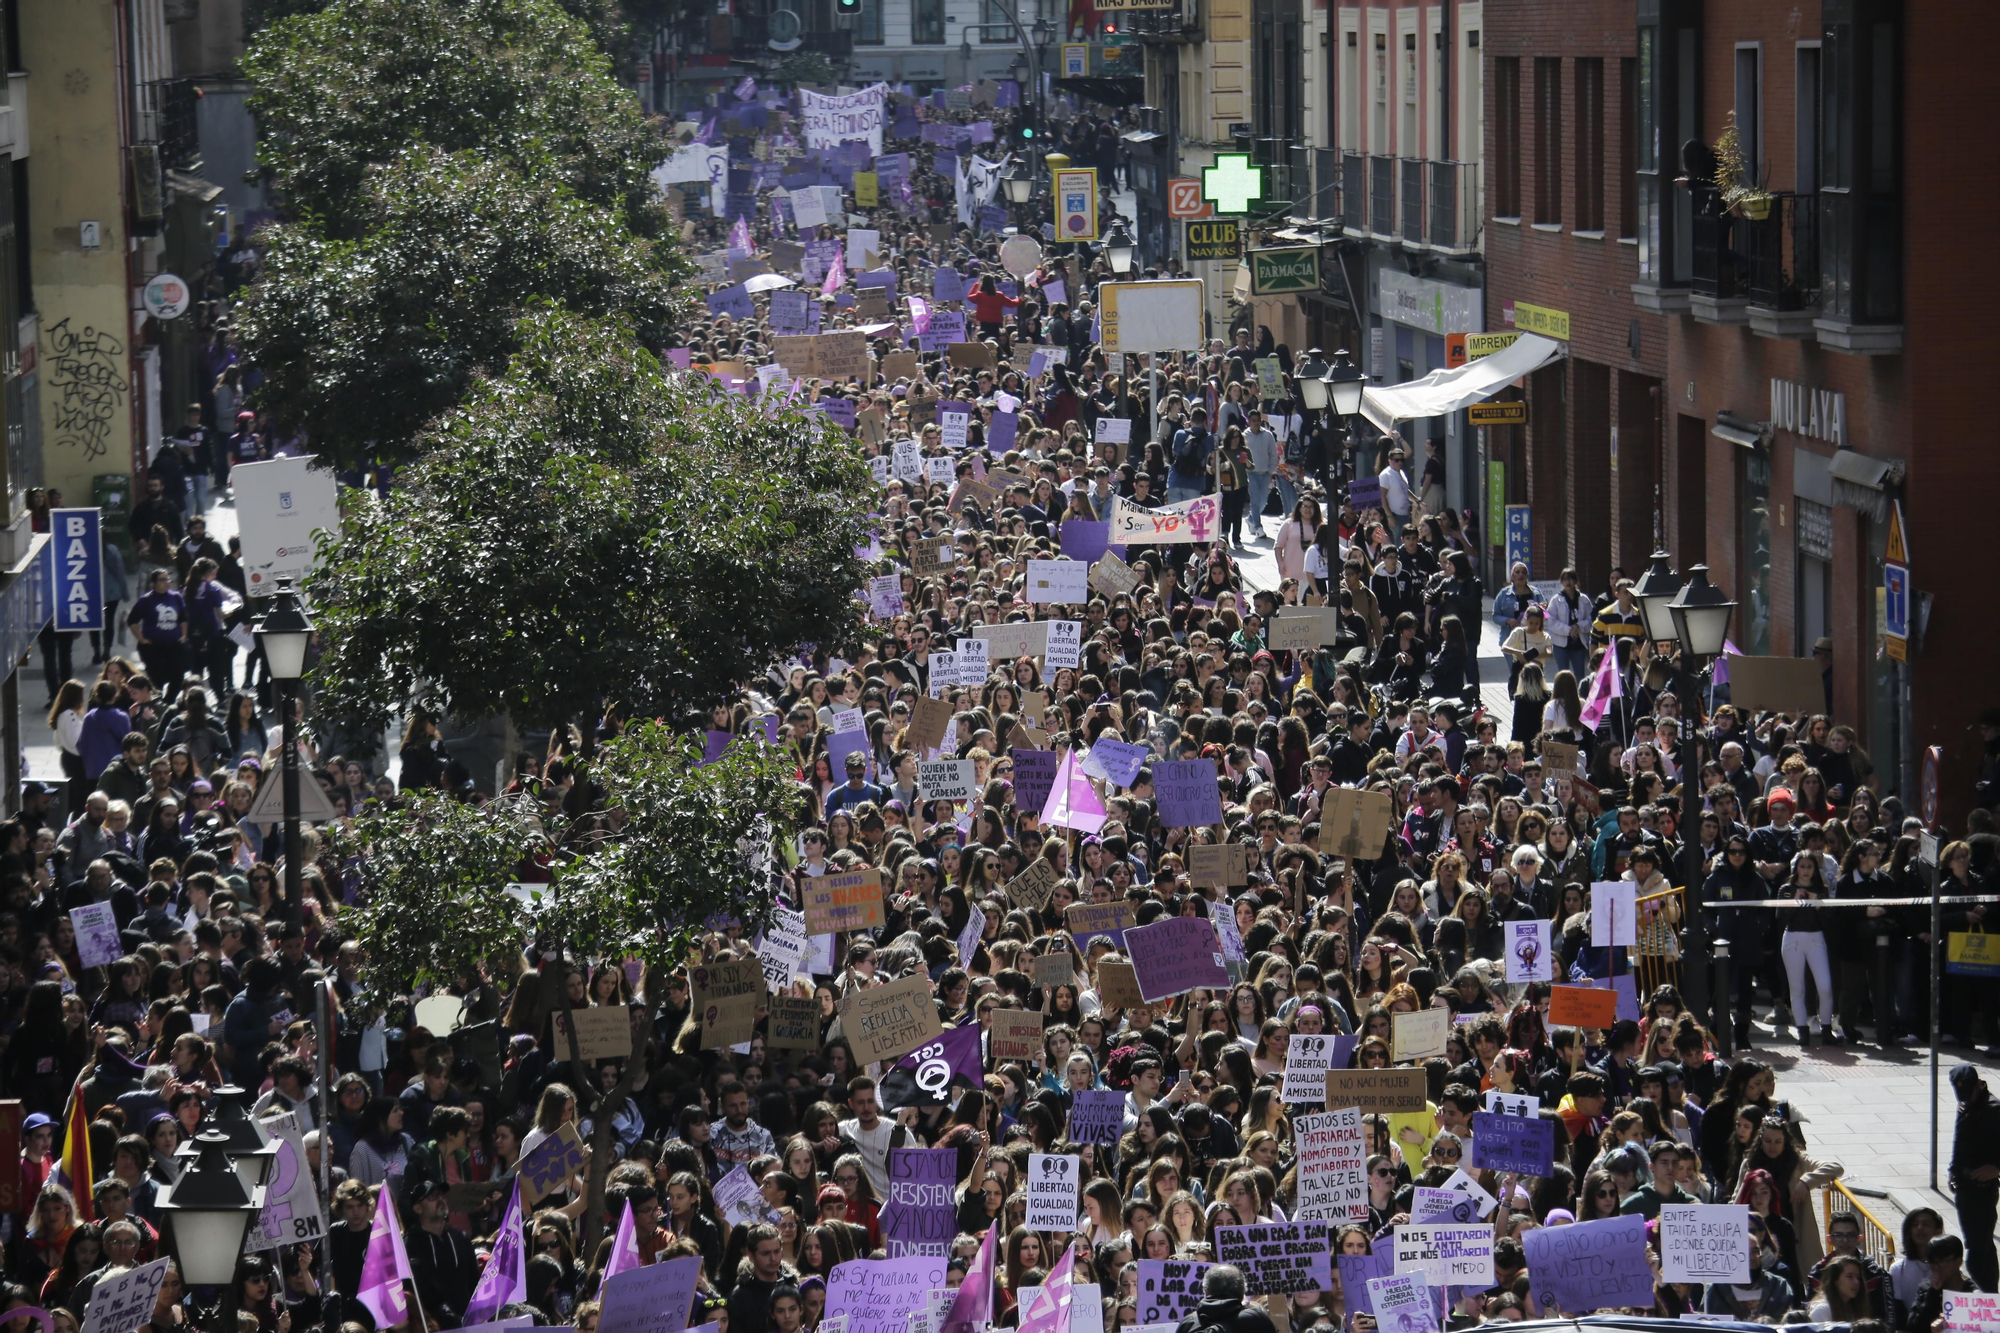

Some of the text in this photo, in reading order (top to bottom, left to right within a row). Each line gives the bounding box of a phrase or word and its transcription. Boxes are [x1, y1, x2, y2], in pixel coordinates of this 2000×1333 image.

[1189, 223, 1237, 244] CLUB
[1190, 247, 1236, 257] NAYKAS
[1259, 263, 1314, 279] FARMACIA
[1771, 378, 1844, 446] MULAYA
[898, 444, 915, 454] JUS-
[1492, 463, 1500, 544] INTERNET
[1125, 516, 1179, 533] Ser YO
[915, 555, 939, 566] ABAJO
[66, 516, 90, 624] BAZAR
[1048, 637, 1078, 645] LIBERTAD,
[1048, 647, 1078, 656] IGUALDAD,
[1047, 656, 1077, 665] AMISTAD.
[921, 763, 957, 774] QUIEN NO
[1039, 757, 1047, 766] EL
[921, 772, 959, 782] MUEVE NO
[930, 786, 968, 798] CADENAS
[804, 874, 864, 892] SE DEBEMOS
[1010, 860, 1050, 897] QUE LAS
[815, 884, 882, 906] LAS MUJERES
[809, 905, 858, 919] QUE NUNCA
[1069, 911, 1078, 924] EL
[813, 916, 864, 931] VOLVIERON
[1960, 951, 1991, 962] MARINA
[709, 966, 741, 985] NO SOY
[709, 981, 756, 997] TUYA NI DE
[772, 997, 819, 1009] LO CONTRARIO
[859, 989, 915, 1015] Sembraremos
[770, 1009, 780, 1019] AL
[773, 1026, 814, 1040] IGNORANCIA
[871, 1021, 928, 1054] LIBERTAD
[1340, 1074, 1409, 1090] NO NACÍ MUJER
[1094, 1091, 1107, 1102] NOS
[1286, 1087, 1325, 1098] AMISTAD.
[1330, 1095, 1422, 1108] PARA MORIR POR SERLO
[1310, 1112, 1356, 1131] DIOS ES
[1494, 1119, 1525, 1133] ELIJO
[1071, 1123, 1120, 1144] VIVAS
[1303, 1127, 1362, 1147] PATRIARCAL
[1476, 1131, 1508, 1144] VISTO
[1301, 1144, 1361, 1162] HOMÓFOBO Y
[1303, 1159, 1361, 1176] ANTIABORTO
[1489, 1159, 1543, 1175] DESVISTO
[1031, 1182, 1076, 1195] LIBERTAD,
[1301, 1171, 1365, 1192] TAL VEZ EL
[1301, 1188, 1361, 1208] DIABLO NO
[1418, 1189, 1454, 1200] 8 Marzo
[1030, 1198, 1075, 1212] IGUALDAD,
[1428, 1198, 1453, 1206] HUELGA
[1323, 1204, 1369, 1219] TAN MALO
[1663, 1210, 1697, 1222] ENTRE
[293, 1214, 321, 1239] 8M
[889, 1208, 934, 1239] YA NO
[1030, 1214, 1075, 1227] AMISTAD.
[1219, 1224, 1327, 1246] ERA UN TAN
[1401, 1229, 1491, 1243] NOS QUITARON
[1667, 1223, 1741, 1238] TANTA BASURA
[1594, 1227, 1639, 1250] como
[1707, 1239, 1738, 1252] QUEDA
[1221, 1244, 1283, 1262] POBRE QUE
[1425, 1241, 1463, 1251] TANTO
[1400, 1247, 1490, 1262] QUE NOS QUITARON
[1255, 1256, 1313, 1271] FUERTE UN
[1339, 1256, 1365, 1281] POR
[1452, 1262, 1486, 1275] MIEDO
[1685, 1252, 1746, 1272] LIBERTAD?
[830, 1267, 919, 1287] 8M mañana
[1163, 1263, 1189, 1279] HOY
[1262, 1269, 1307, 1283] QUE UNA
[118, 1279, 129, 1292] ES
[1145, 1278, 1185, 1293] A LAS
[1372, 1276, 1411, 1291] 8 Marzo
[1385, 1284, 1413, 1295] HUELGA
[843, 1287, 891, 1305] me toca
[1156, 1294, 1171, 1306] DE
[1381, 1297, 1417, 1309] ESTUDIANTIL
[1383, 1290, 1415, 1302] GENERAL
[1954, 1296, 1997, 1308] NI UNA
[1960, 1323, 1982, 1333] UNA
